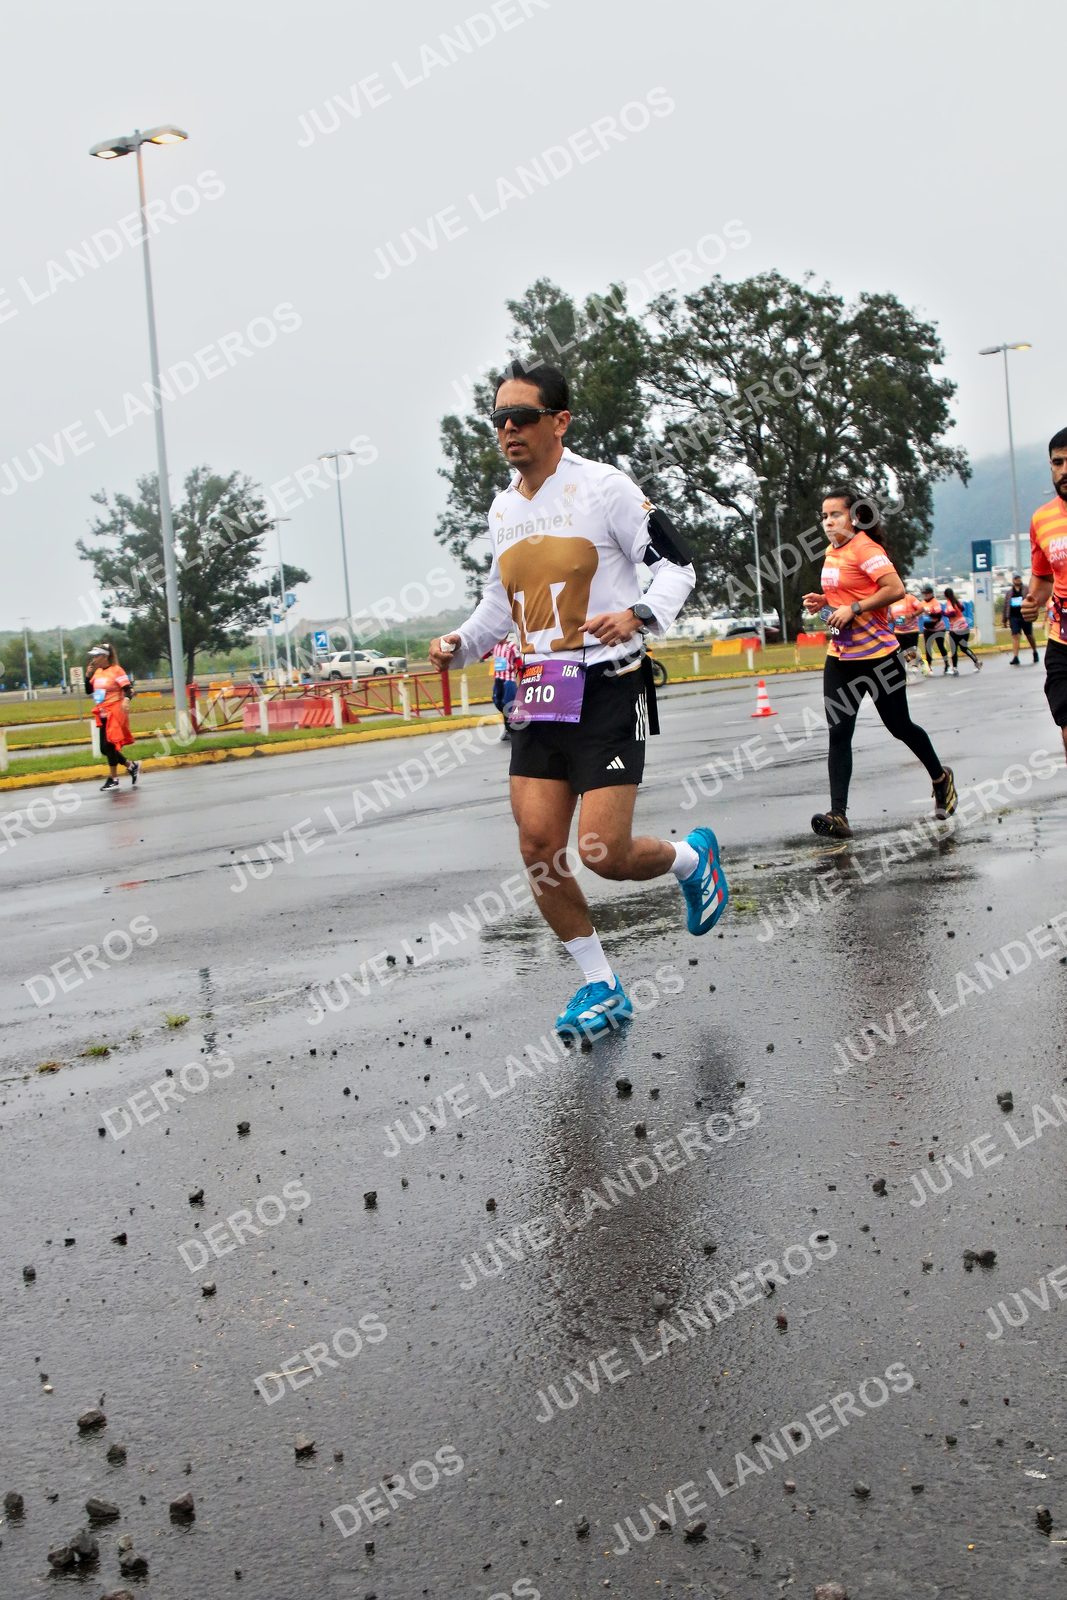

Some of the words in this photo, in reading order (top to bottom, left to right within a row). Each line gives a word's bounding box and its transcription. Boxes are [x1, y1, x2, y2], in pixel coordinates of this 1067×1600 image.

[496, 513, 572, 545] Banamex
[976, 553, 987, 569] E
[524, 684, 555, 704] 810
